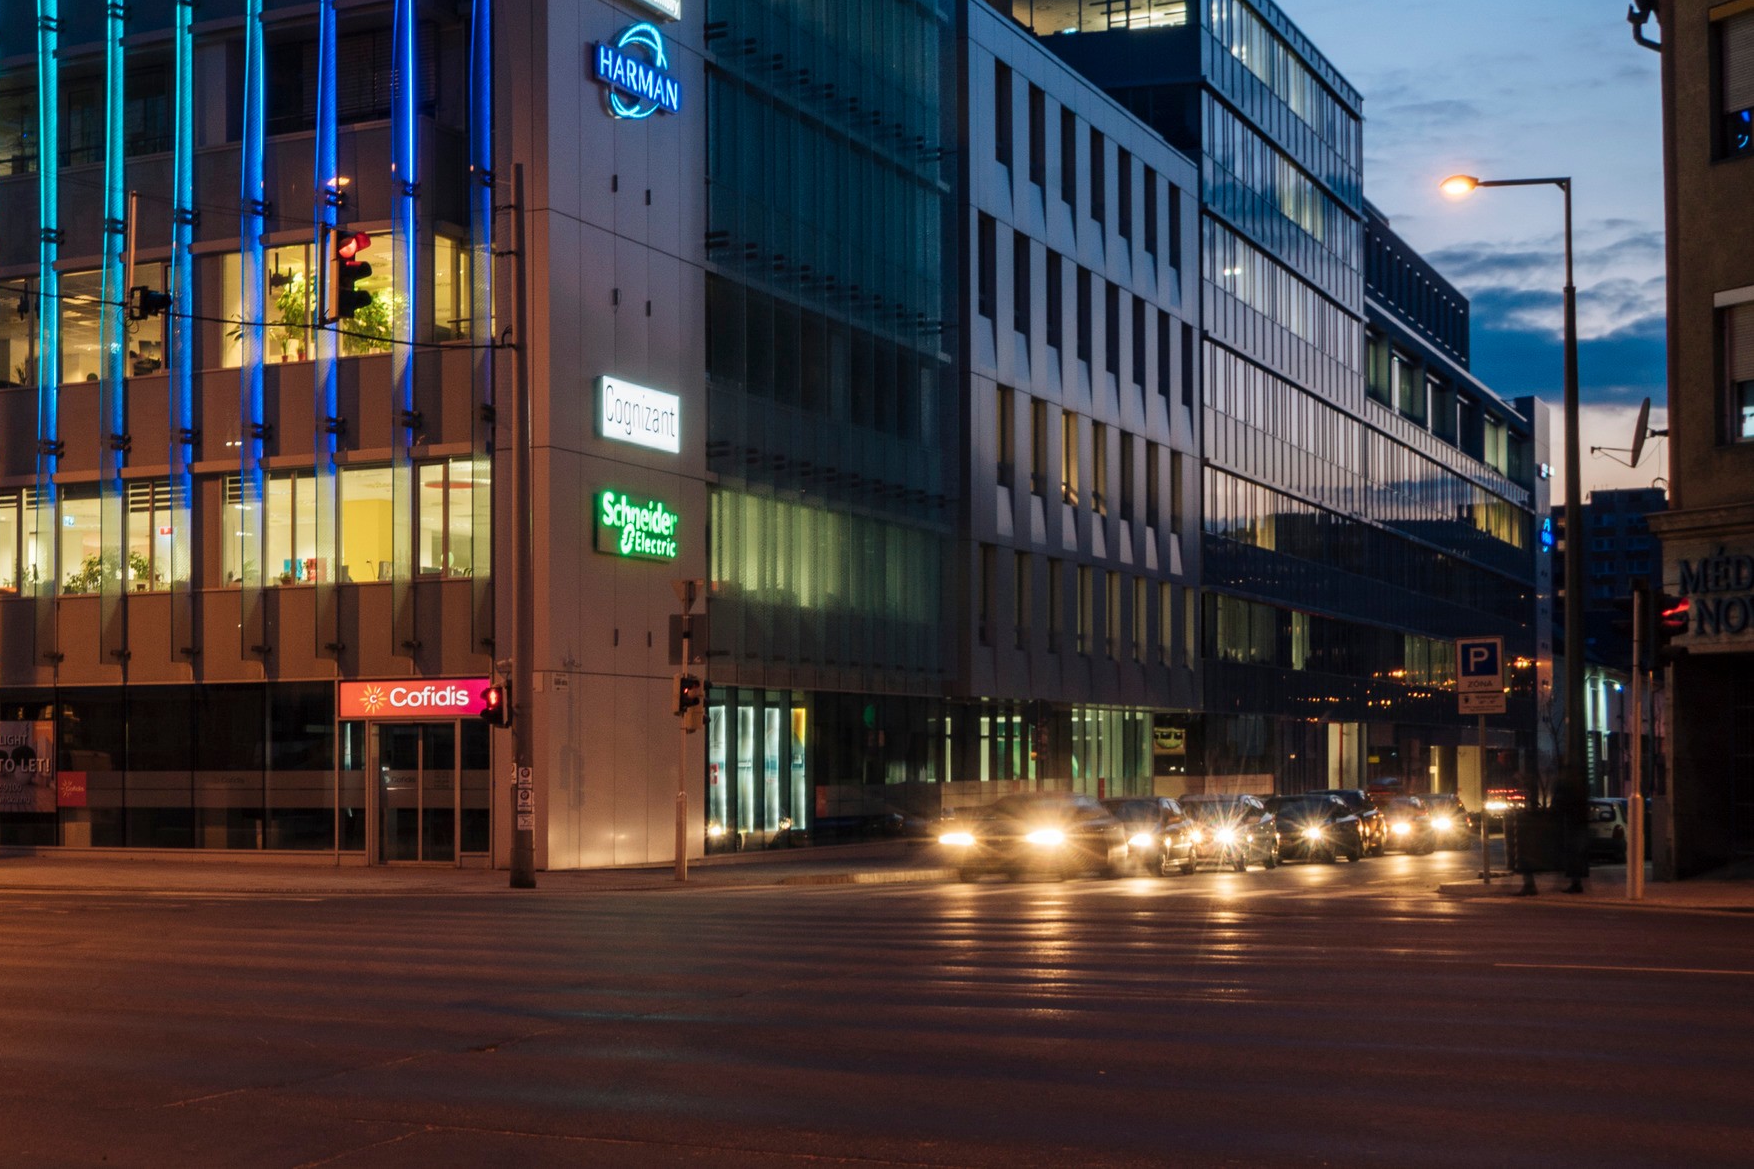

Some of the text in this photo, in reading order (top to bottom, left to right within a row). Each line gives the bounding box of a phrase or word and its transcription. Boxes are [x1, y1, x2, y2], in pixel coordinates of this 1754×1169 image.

[599, 45, 678, 111] HARMAN
[605, 384, 675, 437] Cognizant
[602, 491, 678, 536] Schneider
[635, 530, 676, 558] Electric
[1695, 596, 1754, 636] NO
[1469, 647, 1489, 672] P
[389, 686, 470, 707] Cofidis
[1467, 680, 1493, 688] ZÓNA
[0, 734, 28, 746] LIGHT
[21, 758, 51, 773] LET!
